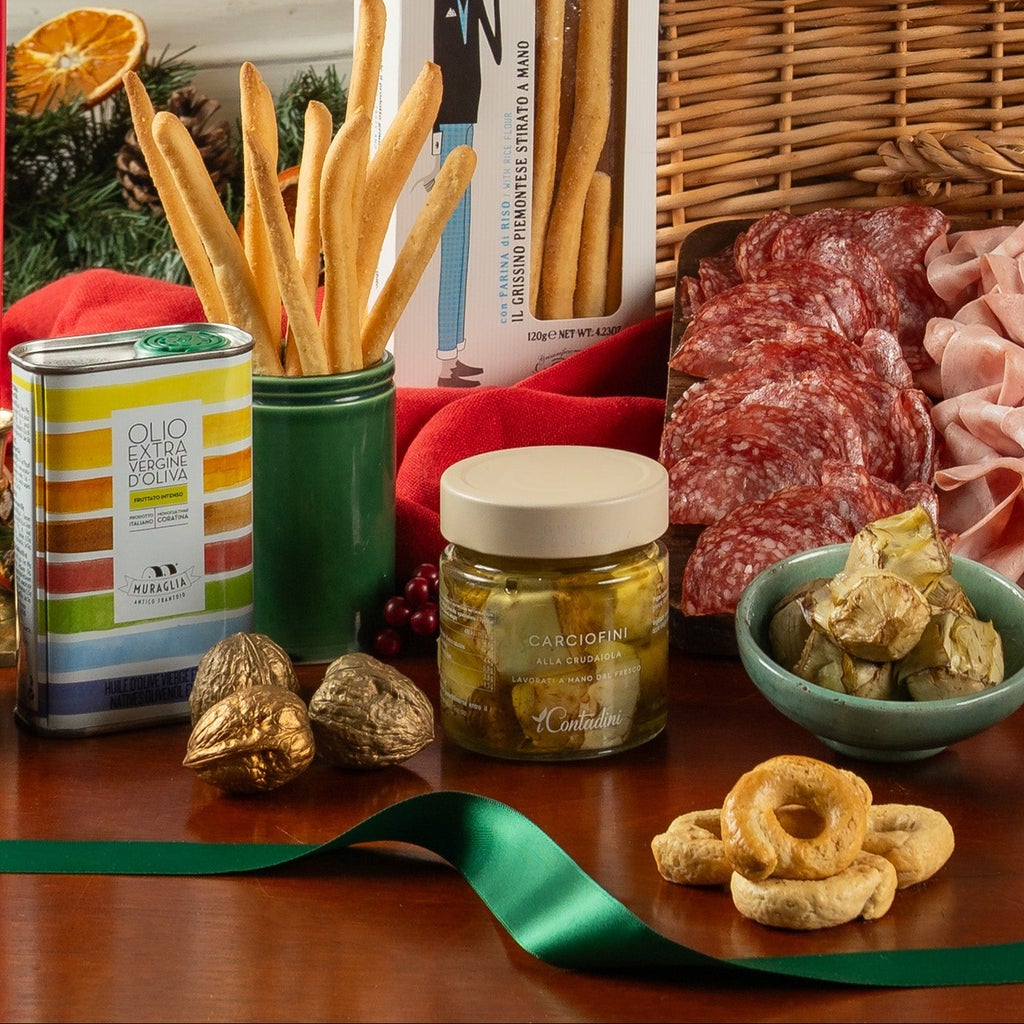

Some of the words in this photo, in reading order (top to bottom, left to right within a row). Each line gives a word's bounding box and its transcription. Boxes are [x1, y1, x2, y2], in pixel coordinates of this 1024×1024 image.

[517, 40, 530, 78] MANO
[517, 83, 529, 92] A
[504, 112, 513, 137] FLOUR
[515, 96, 529, 153] STIRATO
[503, 145, 512, 165] RICE
[503, 168, 511, 189] WITH
[513, 157, 528, 241] PIEMONTESE
[501, 200, 511, 231] RISO
[500, 235, 510, 247] di
[499, 252, 510, 297] FARINA
[512, 245, 526, 305] GRISSINO
[500, 304, 508, 324] con
[512, 310, 524, 323] IL
[527, 331, 547, 341] 120g
[559, 329, 575, 339] NET
[128, 418, 187, 445] OLIO
[128, 440, 187, 462] EXTRA
[129, 454, 188, 473] VERGINE
[129, 468, 188, 488] D'OLIVA
[133, 495, 160, 503] FRUTTATO
[161, 491, 184, 499] INTENSO
[157, 514, 189, 523] CORATINA
[133, 578, 186, 594] MURAGLIA
[158, 592, 186, 603] FRANTOIO
[528, 627, 628, 647] CARCIOFINI
[566, 652, 622, 665] CRUDAIOLA
[511, 676, 555, 684] LAVORATI
[568, 675, 593, 683] MANO
[596, 673, 612, 681] DAL
[615, 665, 642, 678] FRESCO
[545, 706, 623, 734] Contadini
